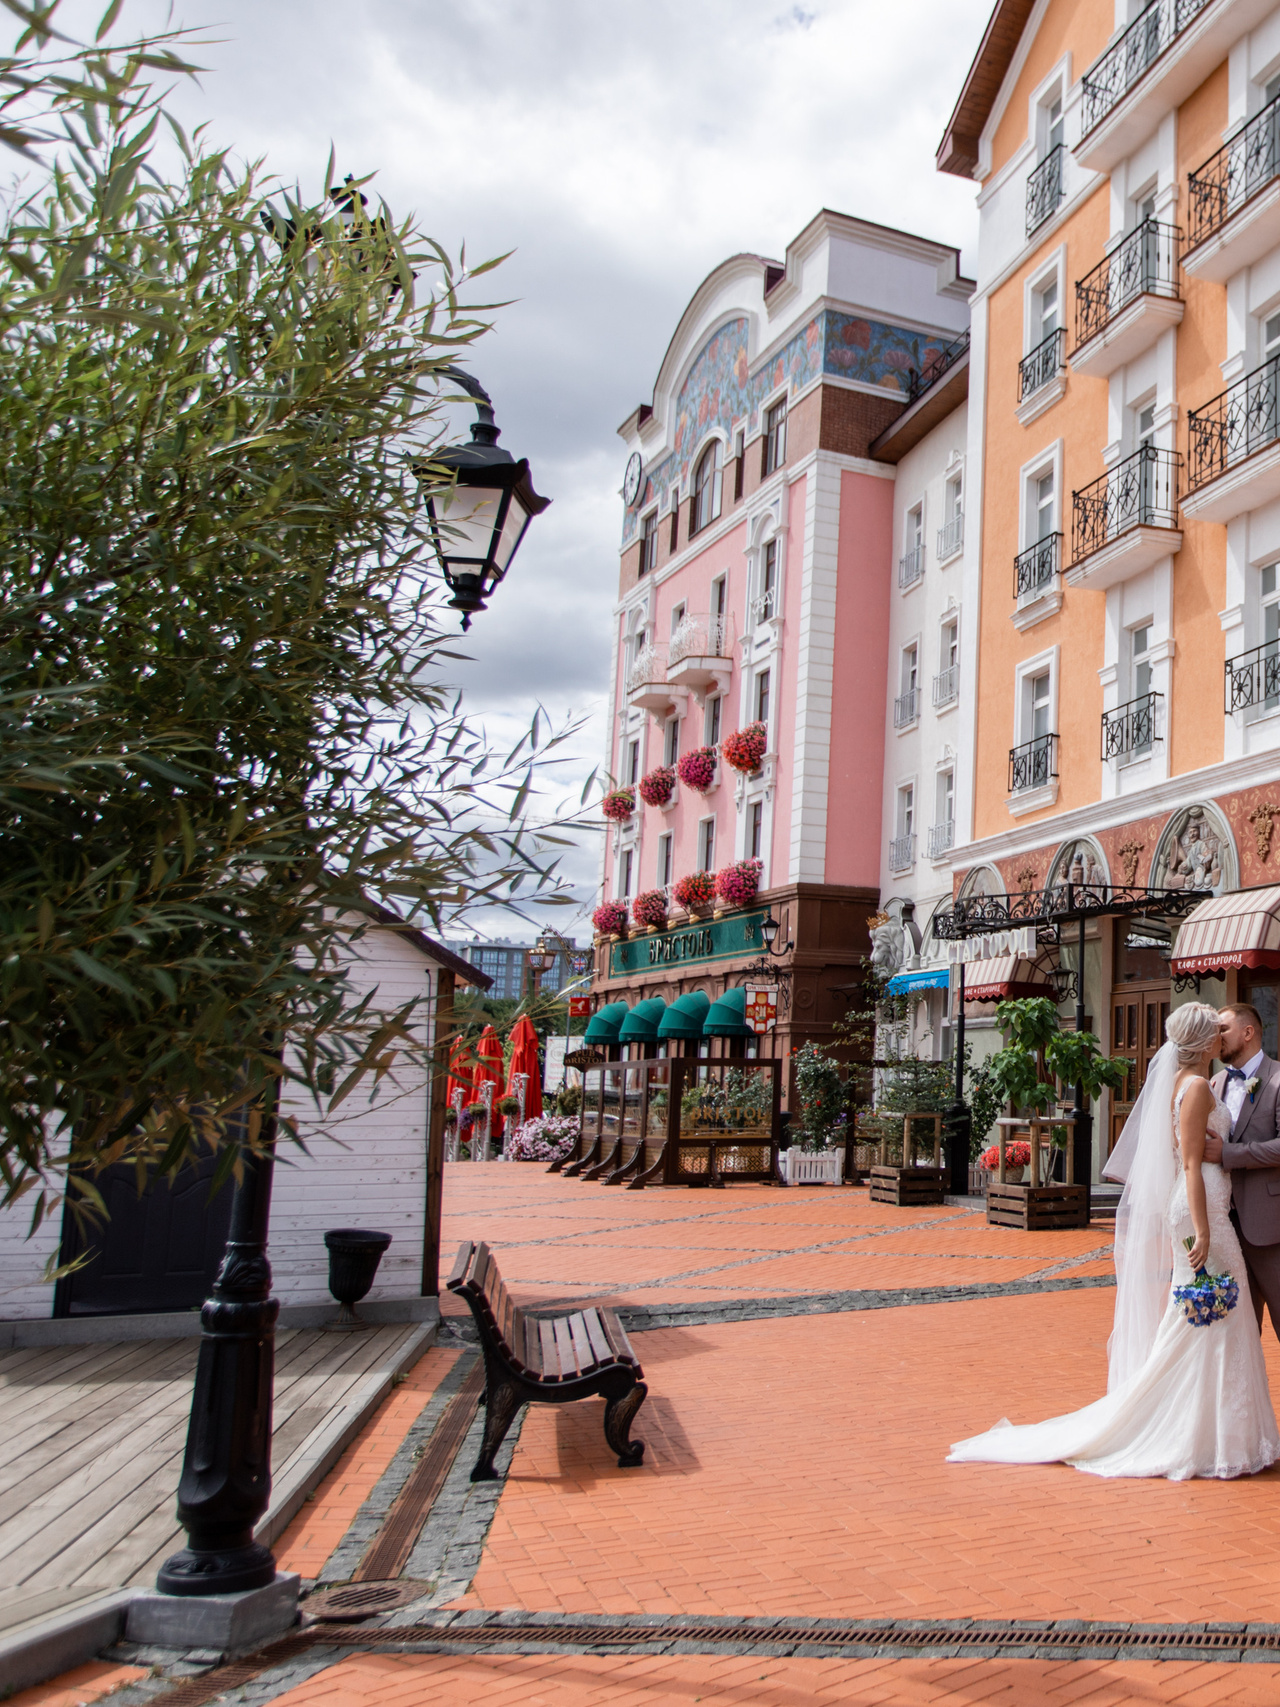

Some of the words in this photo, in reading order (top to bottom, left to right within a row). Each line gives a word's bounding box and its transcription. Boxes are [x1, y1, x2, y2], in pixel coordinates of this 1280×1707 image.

[648, 929, 713, 963] БРИСТОЛЬ
[947, 927, 1037, 964] СТАРГОРОД
[1177, 960, 1196, 970] КАФЕ
[1203, 953, 1243, 967] СТАРГОРОД
[575, 1050, 595, 1058] PUB
[691, 1106, 767, 1121] BRISTOL
